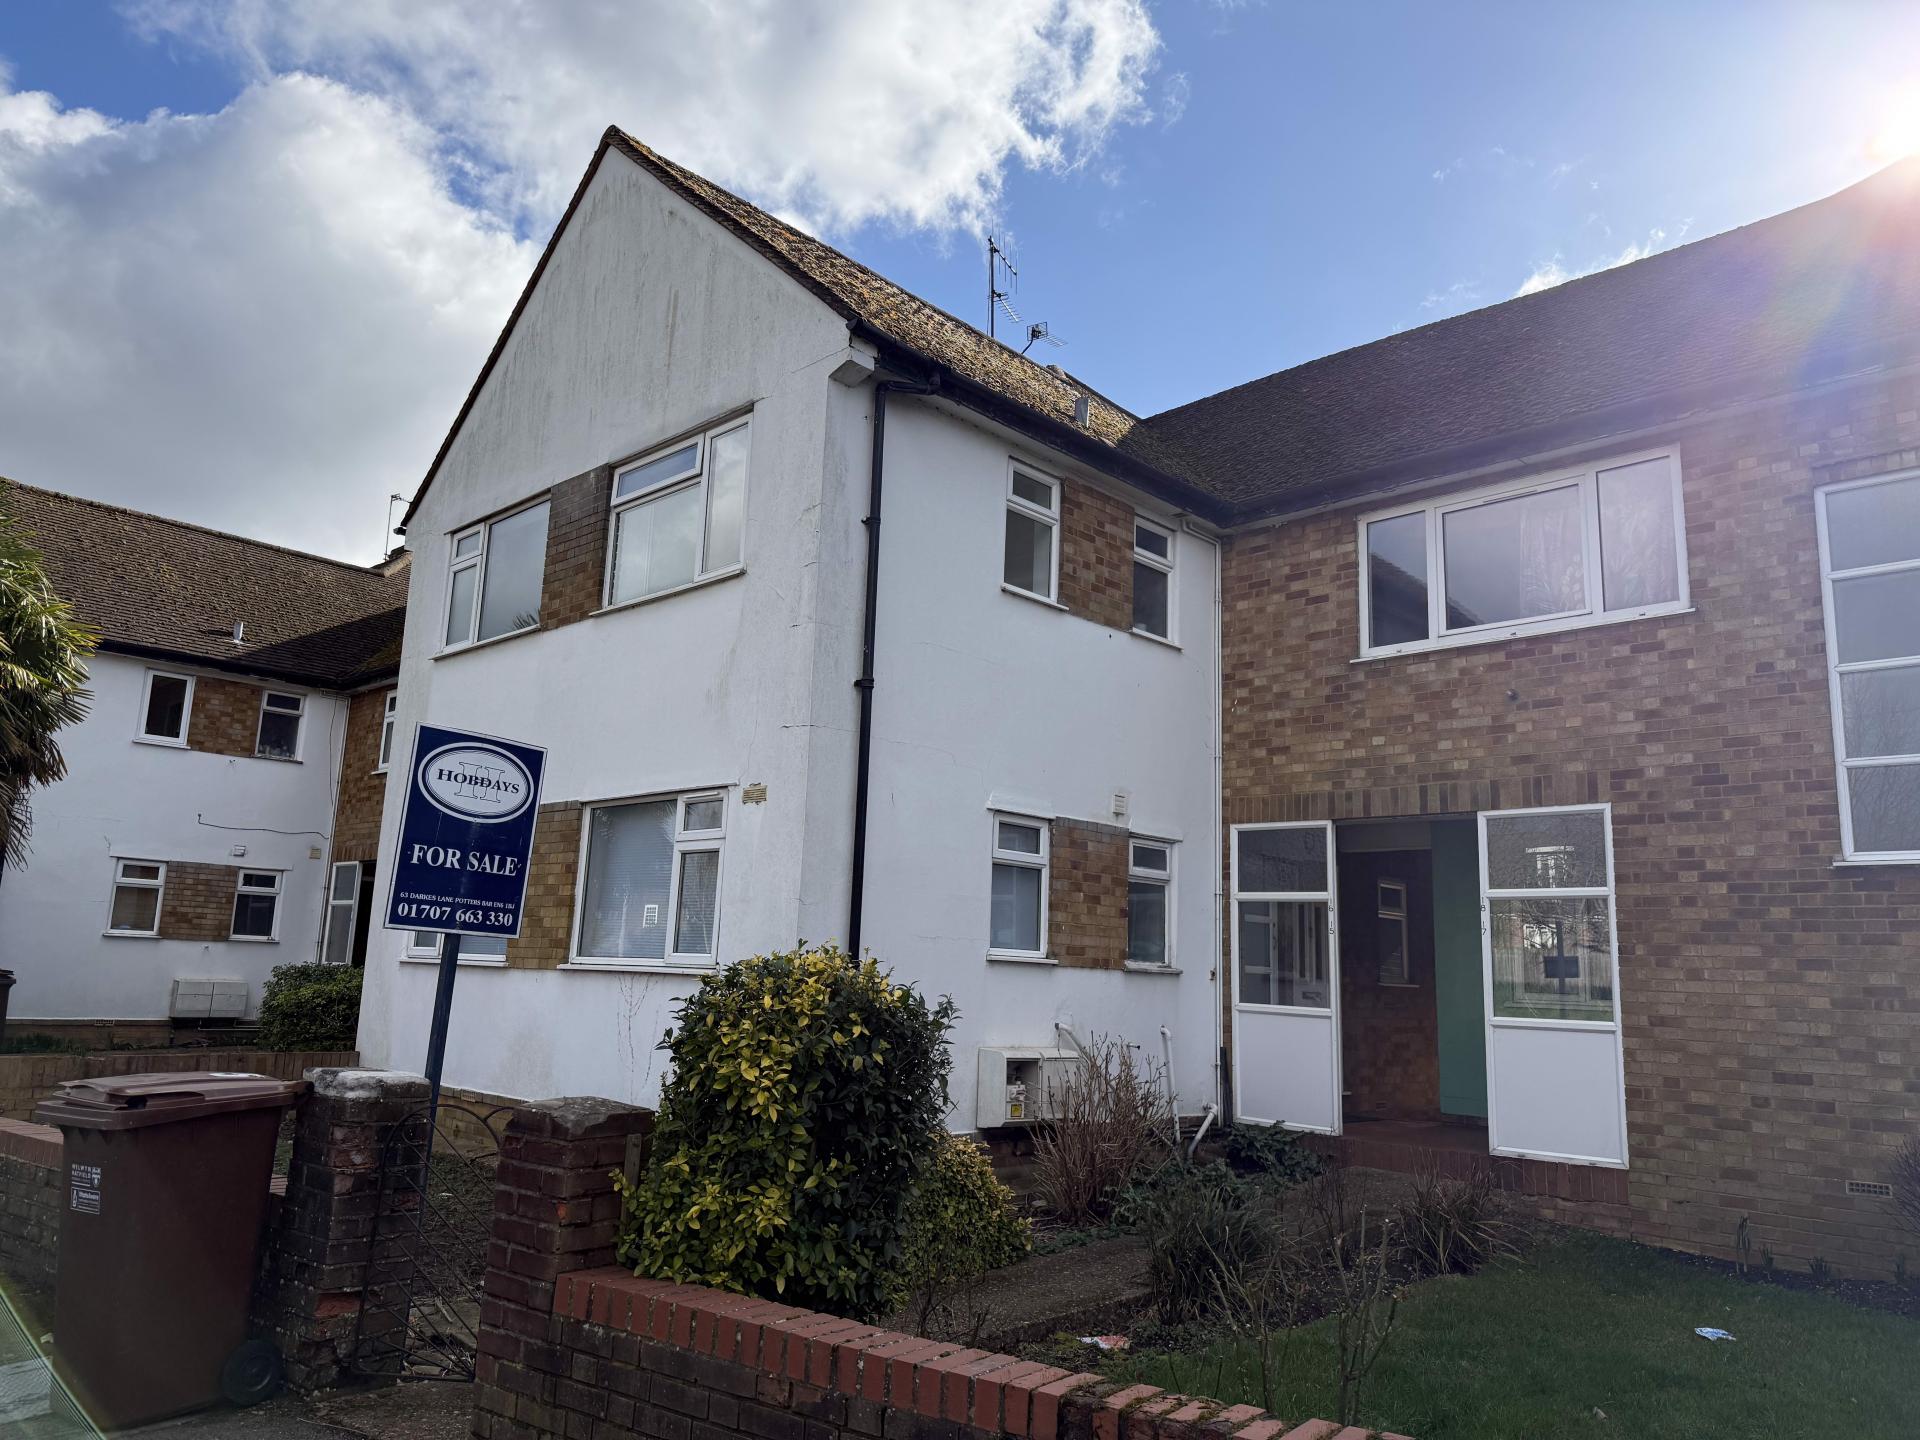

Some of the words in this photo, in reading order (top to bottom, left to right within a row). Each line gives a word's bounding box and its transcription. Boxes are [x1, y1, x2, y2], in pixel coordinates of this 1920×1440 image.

[437, 768, 520, 794] HOBDAYS
[410, 844, 461, 869] FOR
[466, 851, 518, 876] SALE
[409, 892, 437, 901] DARKES
[454, 897, 481, 906] POTTERS
[397, 902, 451, 921] 01707
[455, 908, 484, 924] 663
[486, 911, 513, 927] 330
